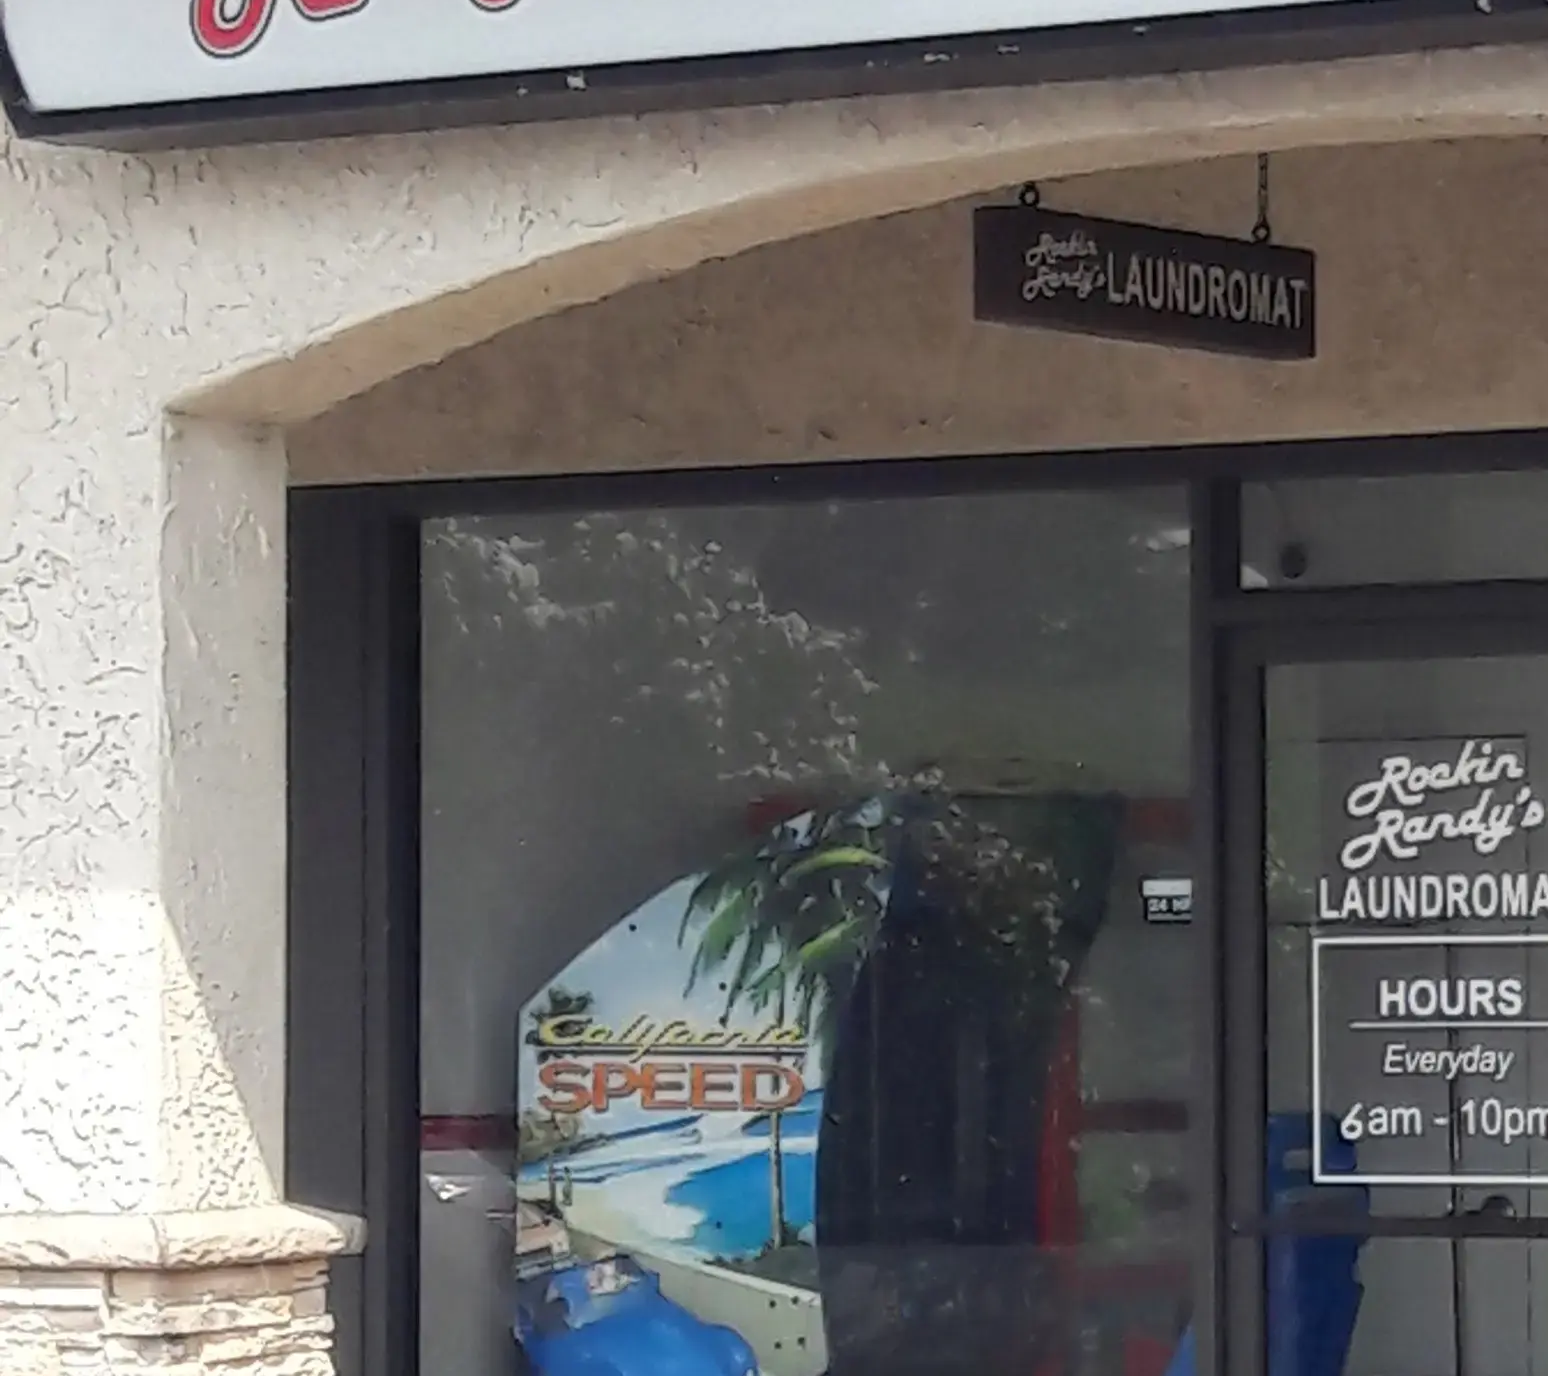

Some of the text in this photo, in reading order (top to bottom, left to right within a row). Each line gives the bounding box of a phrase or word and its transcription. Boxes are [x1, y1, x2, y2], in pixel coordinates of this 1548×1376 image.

[1107, 252, 1308, 329] LAUNDROMAT
[1341, 786, 1546, 869] Randy's
[1379, 979, 1523, 1017] HOURS
[536, 1014, 808, 1064] California
[1383, 1044, 1515, 1081] Everyday
[537, 1060, 806, 1114] SPEED
[1340, 1101, 1422, 1140] 6am
